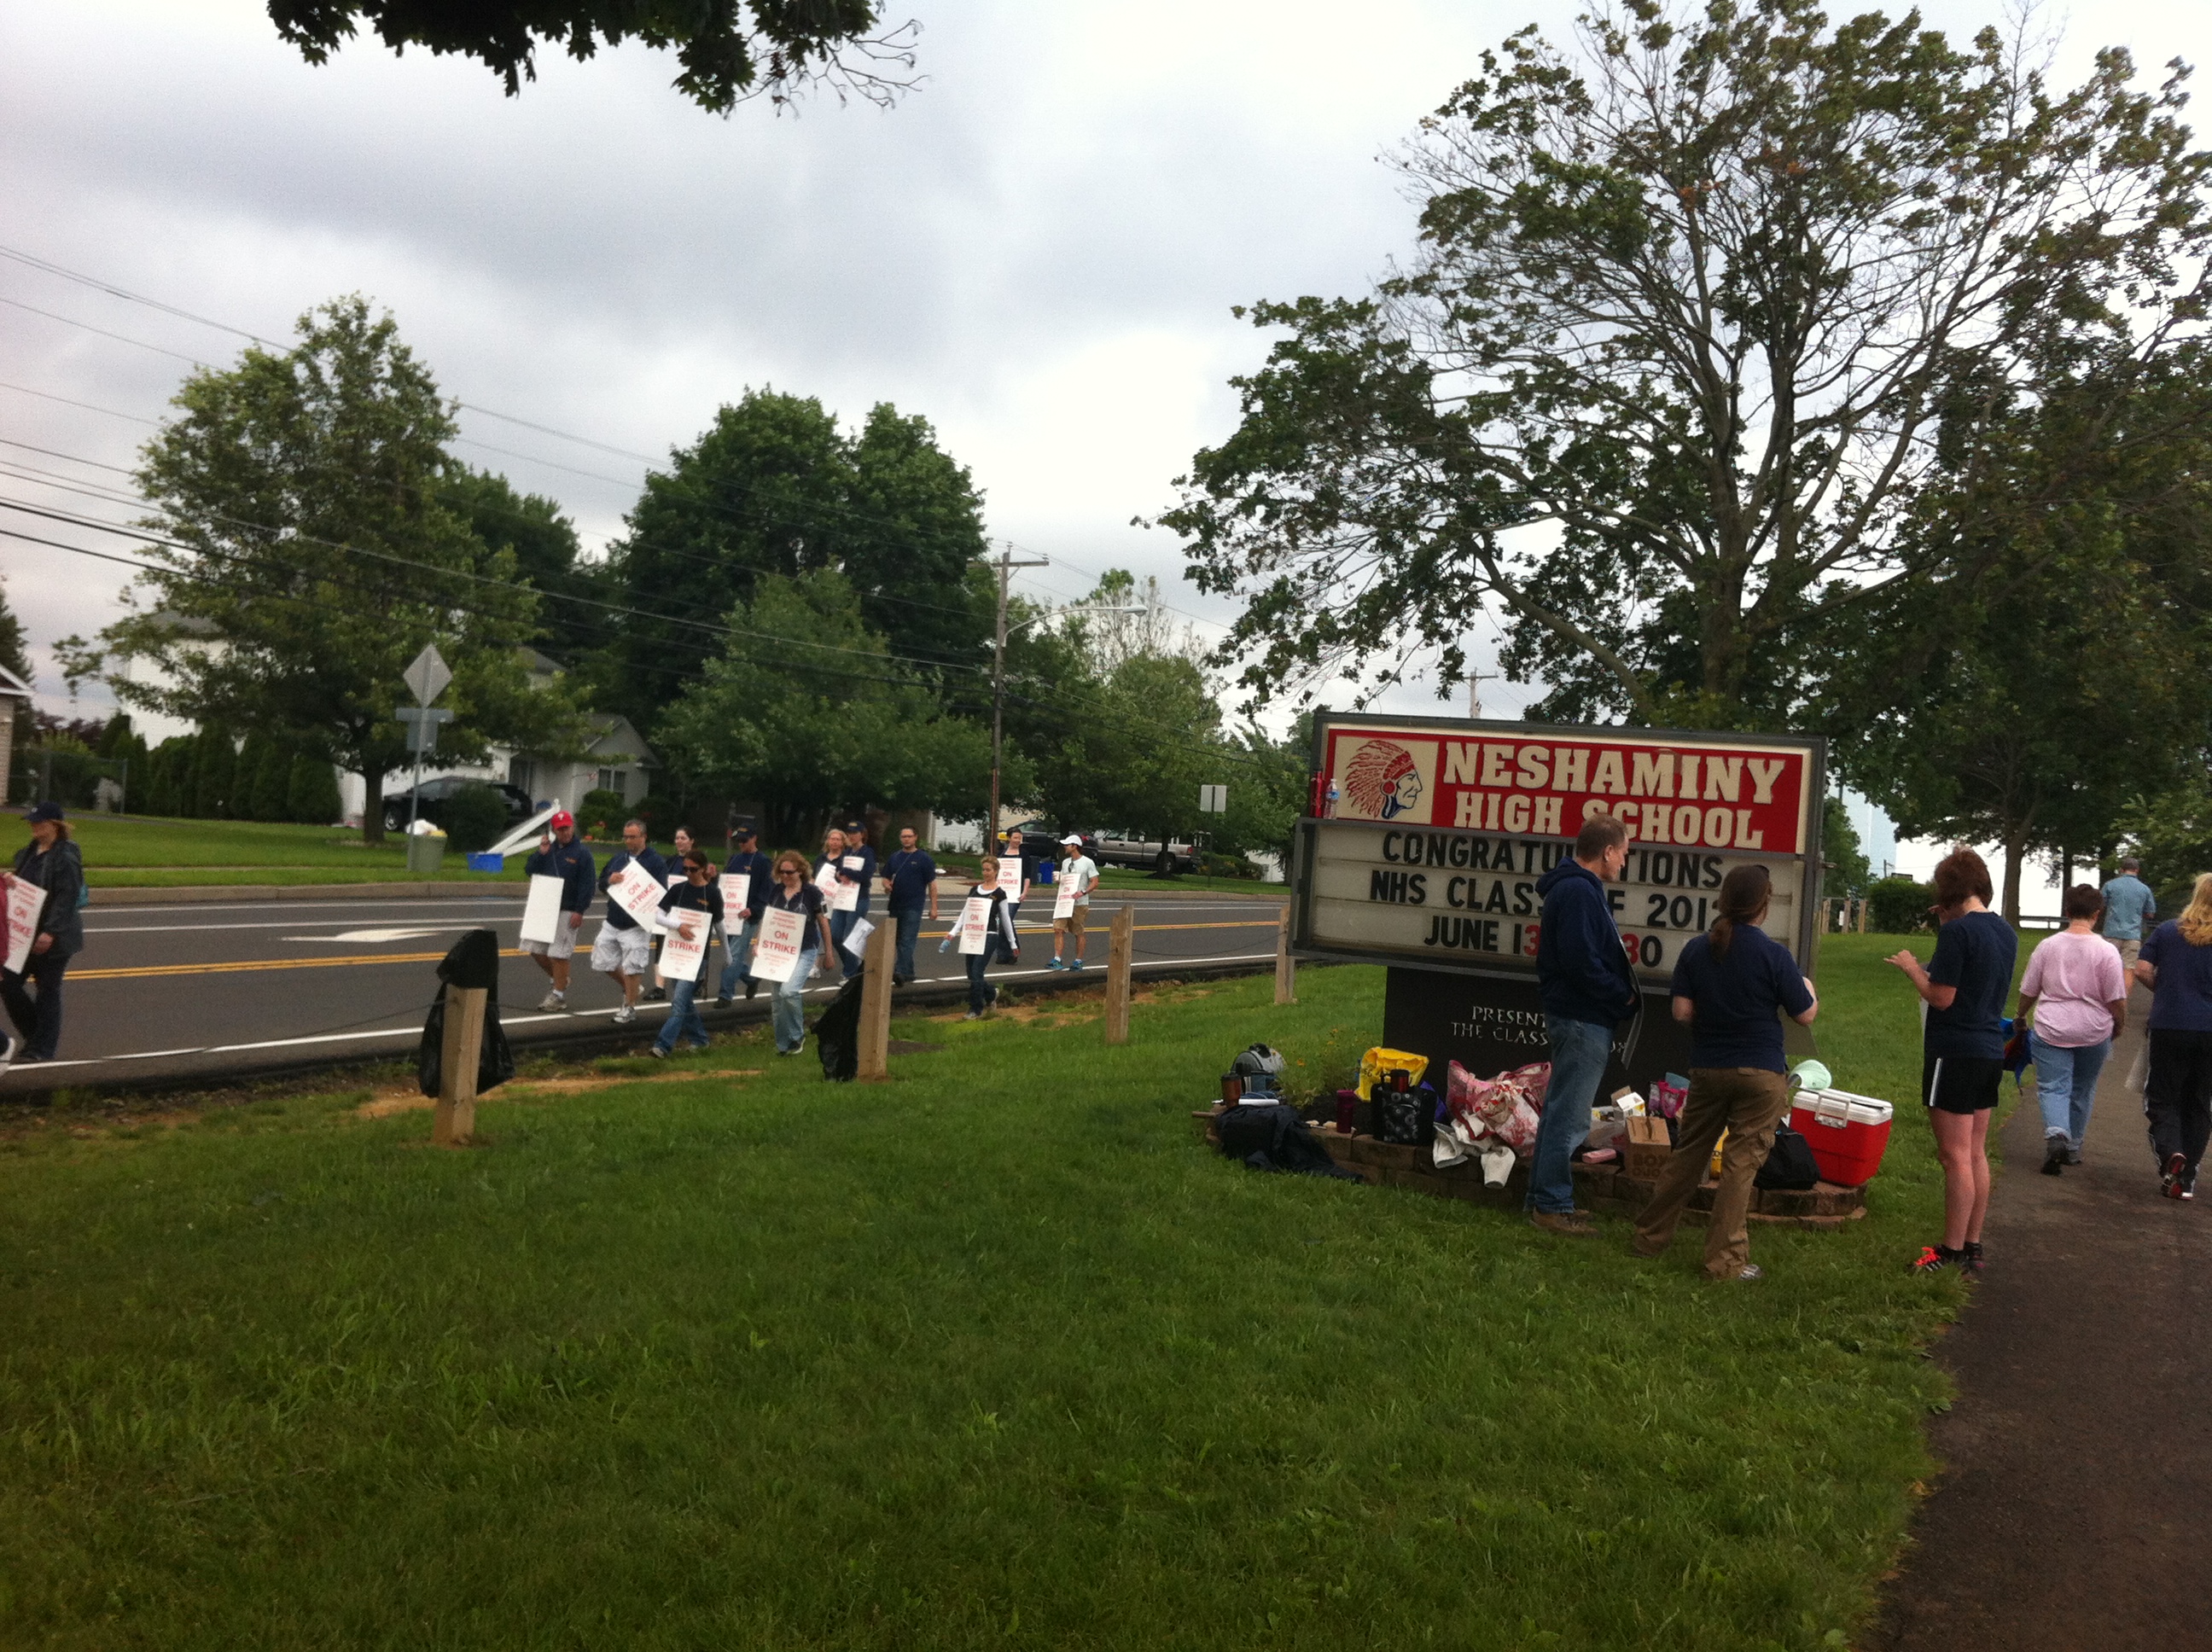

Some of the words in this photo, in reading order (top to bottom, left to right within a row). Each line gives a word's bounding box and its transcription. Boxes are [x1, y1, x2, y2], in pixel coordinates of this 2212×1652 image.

[1443, 741, 1785, 804] NESHAMINY
[1453, 791, 1564, 835] HIGH
[1383, 831, 1723, 888] CONGRATUTIONS
[627, 882, 642, 895] ON
[627, 882, 657, 911] STRIKE
[1370, 869, 1426, 905] NHS
[1447, 876, 1543, 916] CLAS
[1606, 888, 1626, 919] F
[774, 930, 789, 940] ON
[964, 923, 985, 932] STRIKE
[1423, 916, 1500, 952] JUNE
[1513, 922, 1541, 957] 13
[667, 939, 701, 953] STRIKE
[762, 939, 798, 955] STRIKE
[1451, 1021, 1483, 1039] THE
[1493, 1027, 1549, 1046] CLASS
